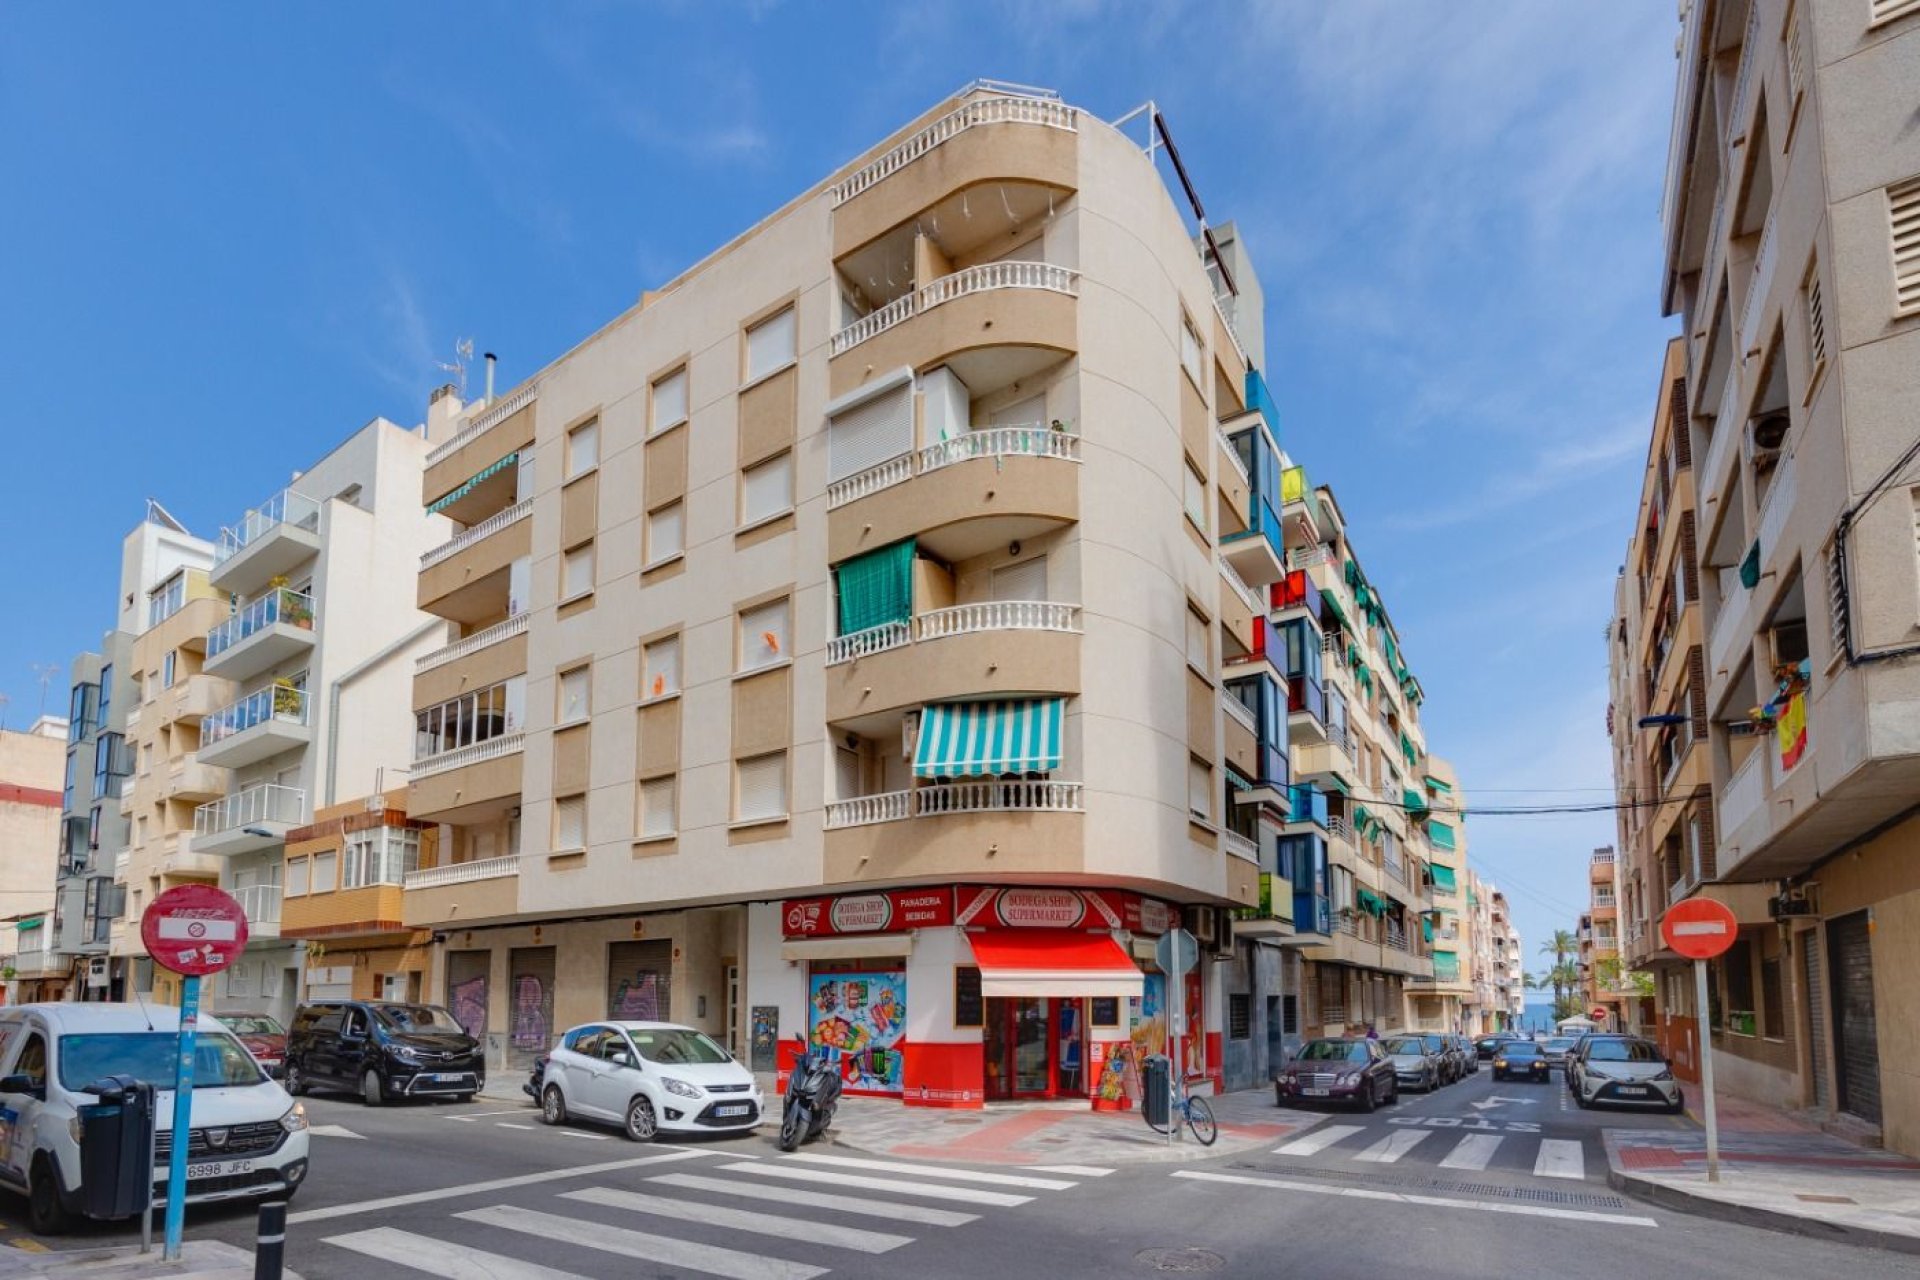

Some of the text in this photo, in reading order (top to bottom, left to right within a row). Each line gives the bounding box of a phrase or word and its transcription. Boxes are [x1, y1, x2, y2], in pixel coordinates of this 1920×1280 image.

[901, 897, 941, 907] PANADERIA
[1008, 895, 1073, 907] BODEGA SHOP
[905, 911, 936, 921] BEBIDAS
[1008, 909, 1073, 920] SUPERMARKET
[188, 1161, 251, 1177] 6998 JFC
